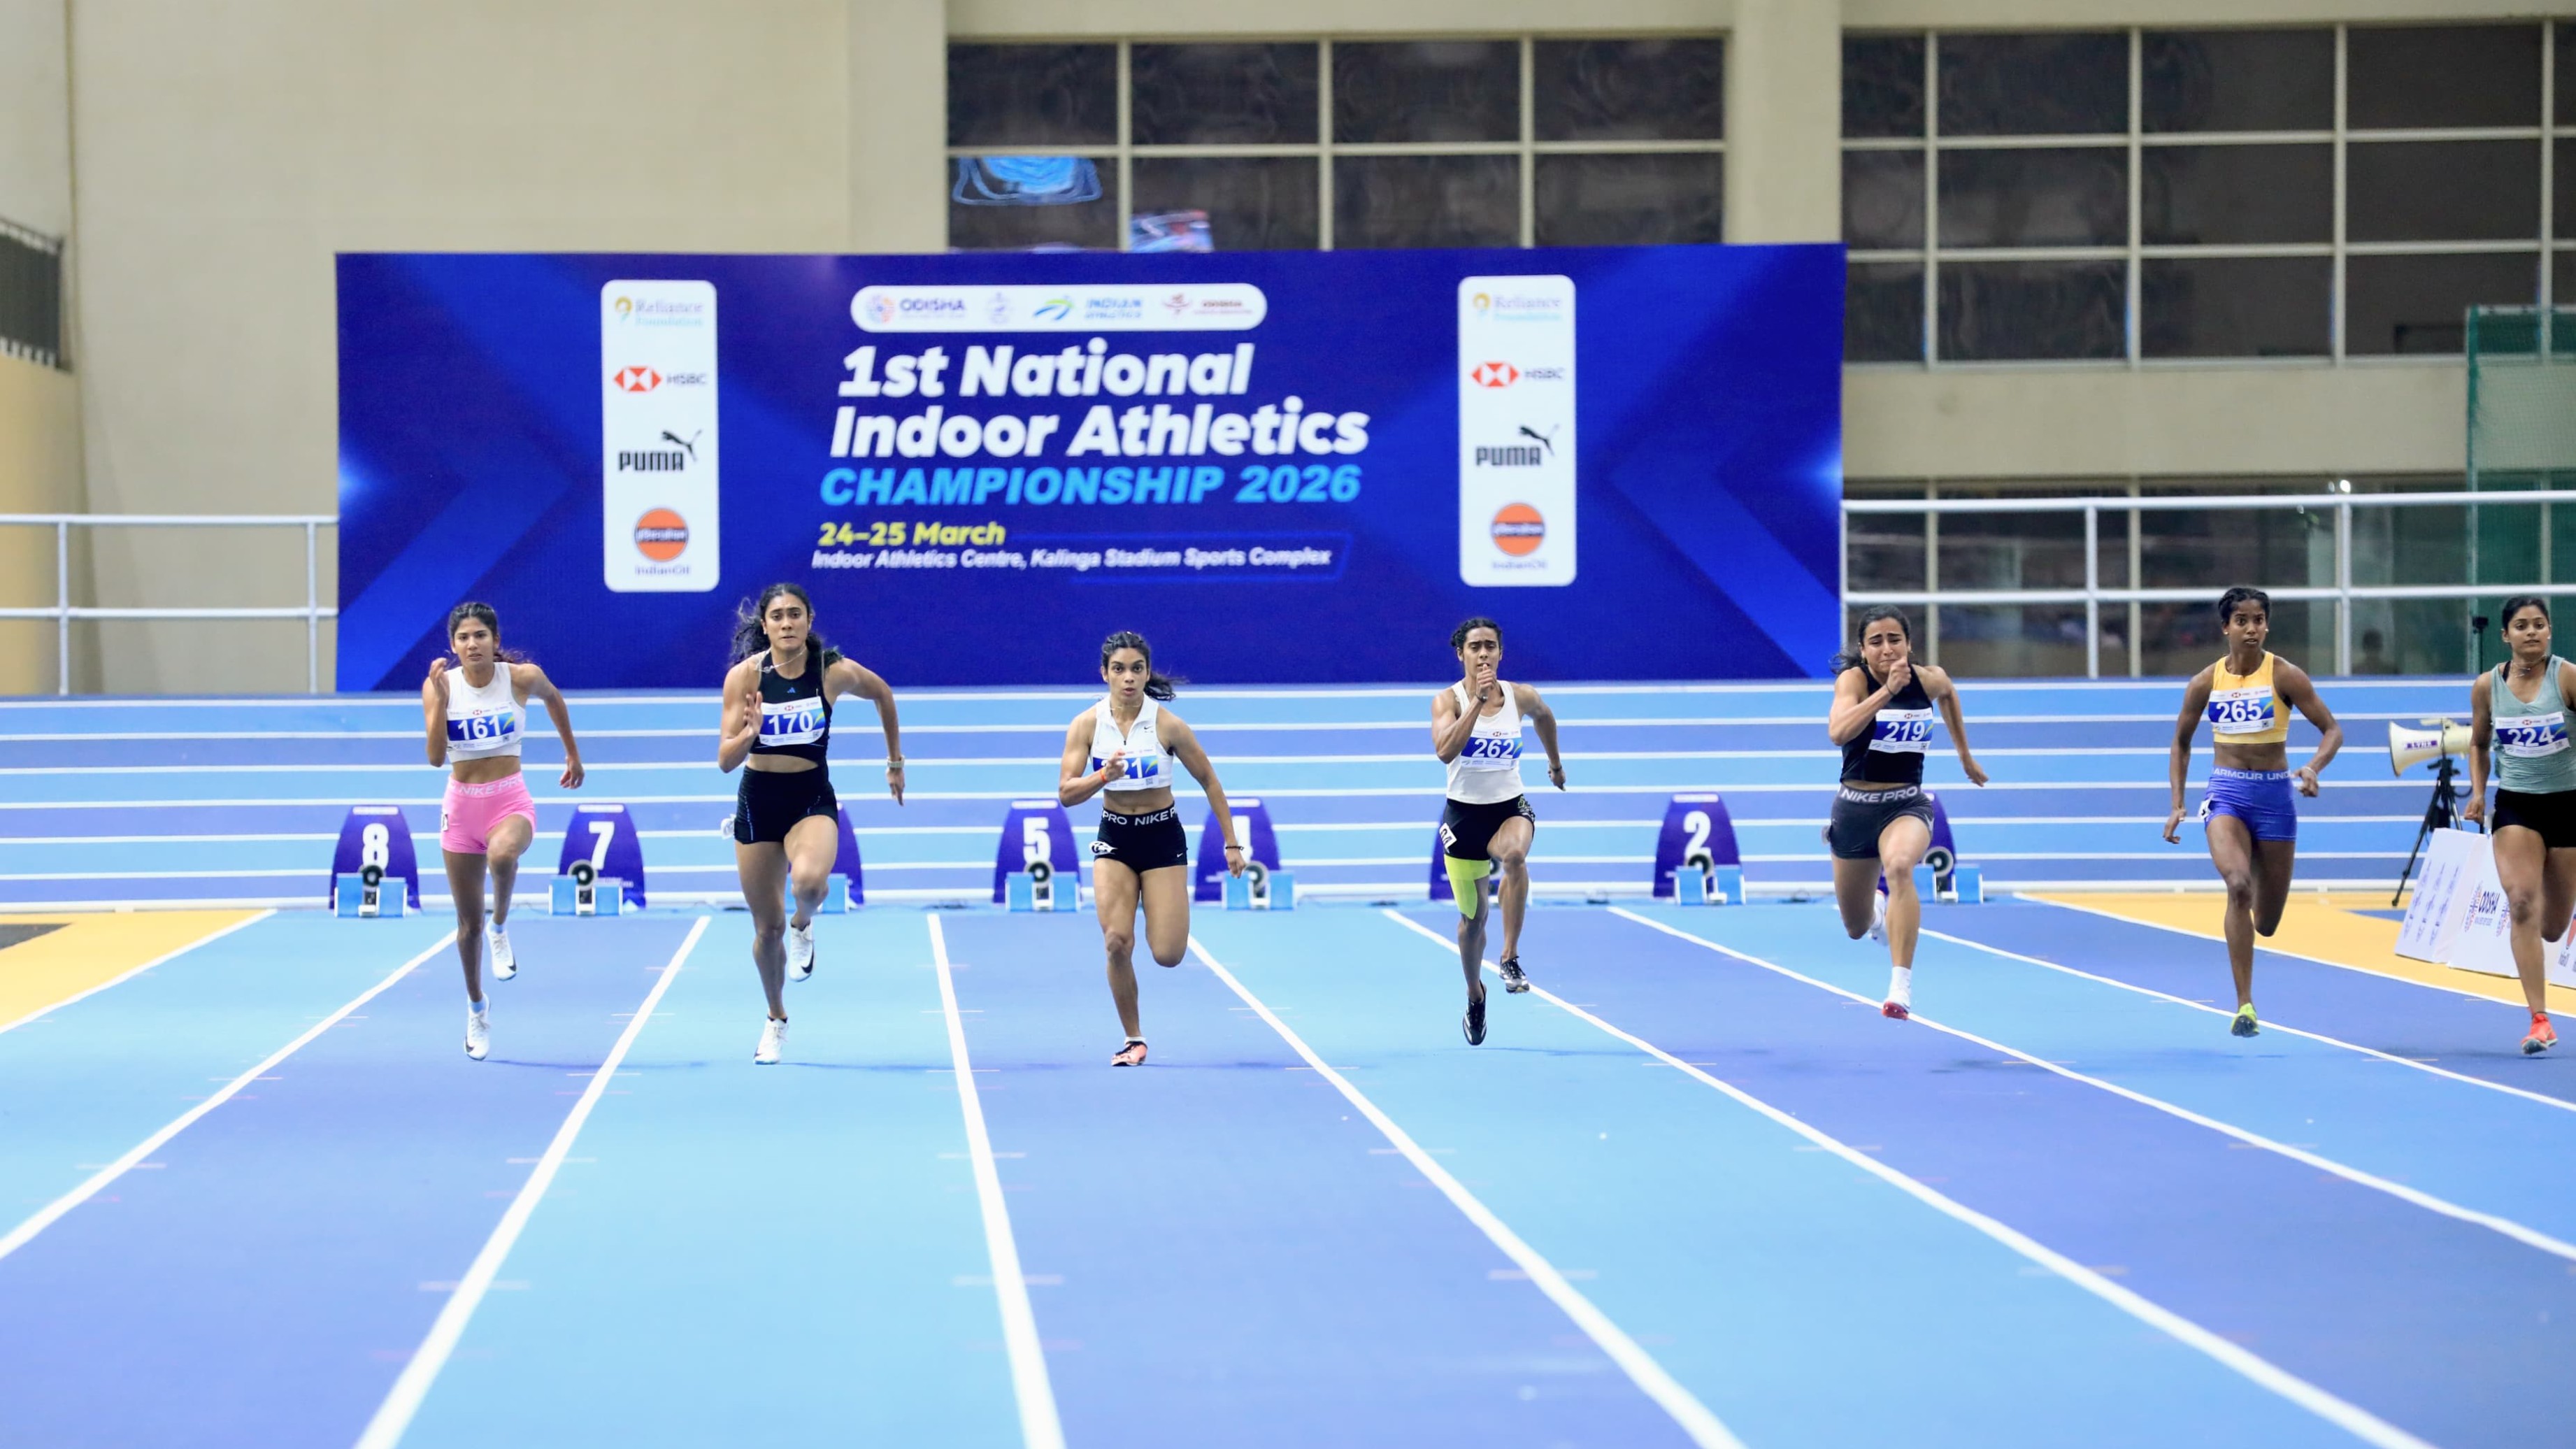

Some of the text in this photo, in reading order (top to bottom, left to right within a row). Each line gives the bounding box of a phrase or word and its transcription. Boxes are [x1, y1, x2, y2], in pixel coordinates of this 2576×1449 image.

[899, 298, 966, 312] ODISHA
[838, 336, 1256, 398] 1st National
[666, 373, 706, 385] HSBC
[829, 396, 1371, 458] Indoor Athletics
[618, 450, 685, 472] PUMA
[1475, 445, 1542, 467] PUMA
[820, 464, 1362, 506] CHAMPIONSHIP 2026
[912, 521, 1007, 545] March
[811, 546, 1333, 572] Indoor Athletics Centre, Kalinga Stadium Sports Complex
[2216, 699, 2262, 723] 265
[457, 715, 501, 741] 161
[768, 711, 813, 734] 170
[1883, 721, 1925, 741] 219
[2507, 726, 2554, 747] 224
[1472, 738, 1515, 759] 262
[1101, 757, 1143, 779] 21
[2214, 768, 2290, 780] ARMOUR UND
[459, 776, 522, 795] NIKE PR
[1841, 786, 1918, 802] NIKE PRO
[1103, 809, 1127, 825] PRO
[1134, 811, 1169, 826] NIKE
[362, 822, 389, 871] 8
[588, 821, 616, 870] 7
[1023, 817, 1051, 864] 5
[1682, 811, 1712, 864] 2
